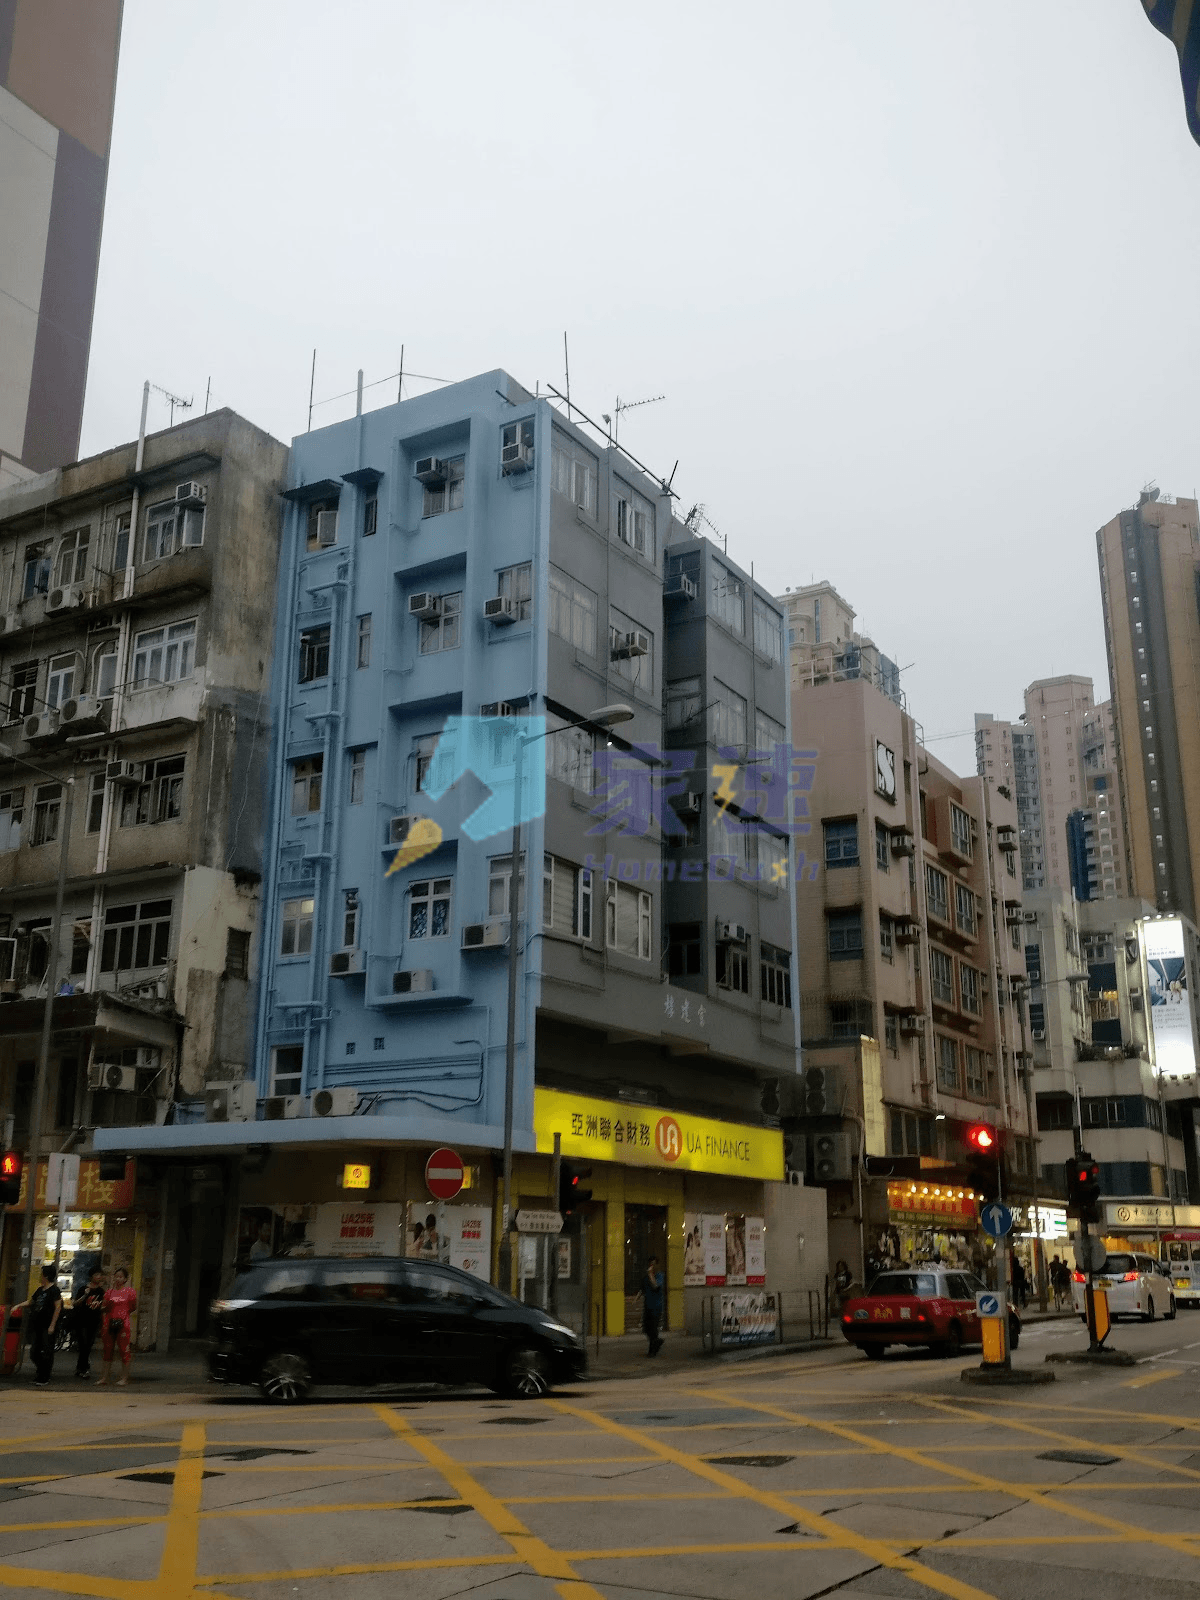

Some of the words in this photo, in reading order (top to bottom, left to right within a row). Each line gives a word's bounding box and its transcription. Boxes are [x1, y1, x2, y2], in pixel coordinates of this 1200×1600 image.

[571, 1113, 651, 1147] 亞洲聯合財務
[686, 1131, 703, 1154] UA
[705, 1135, 750, 1162] FINANCE
